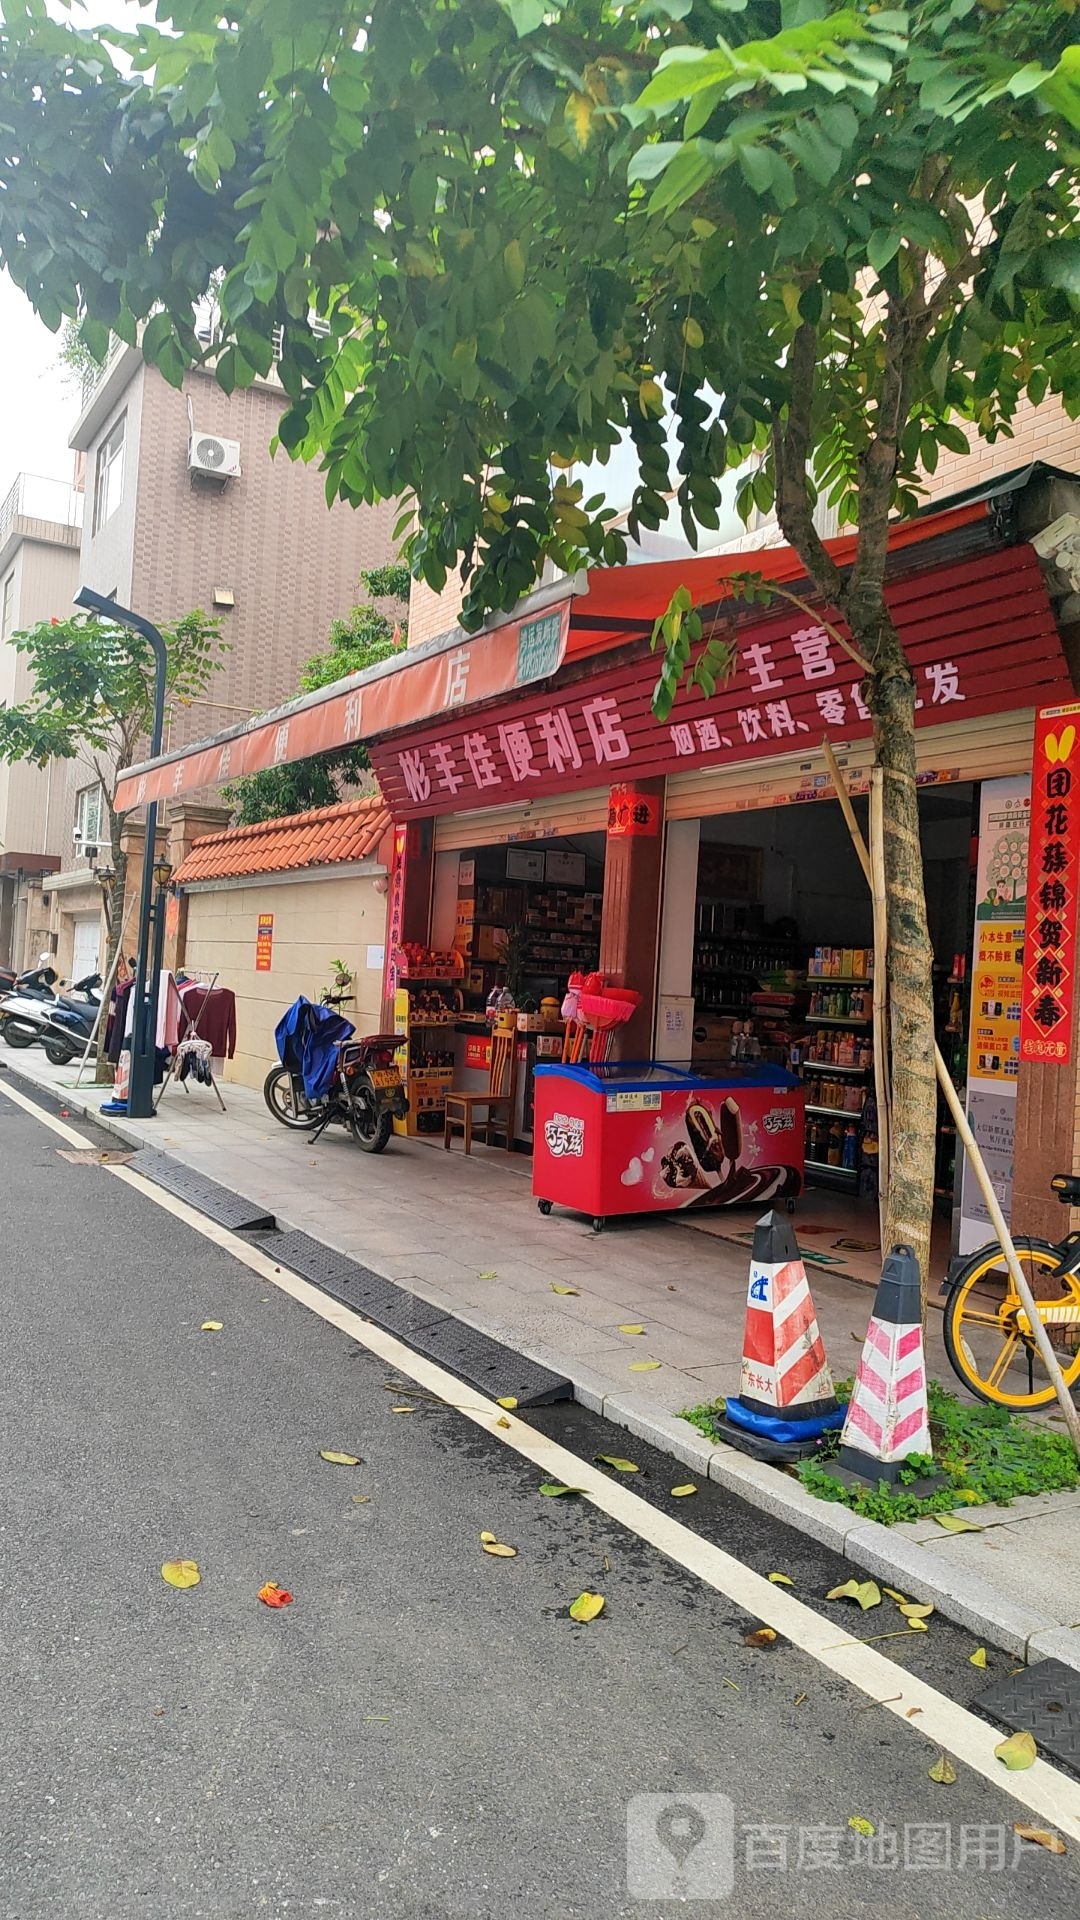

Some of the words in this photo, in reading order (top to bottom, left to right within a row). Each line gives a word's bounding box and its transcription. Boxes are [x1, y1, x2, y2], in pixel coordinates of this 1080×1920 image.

[742, 626, 836, 693] 主营
[398, 697, 631, 803] 彬丰佳便利店
[669, 661, 967, 757] 烟酒、饮料、零售发
[980, 931, 1013, 944] 小本生意
[1034, 766, 1072, 1027] 团花簇锦贺新春
